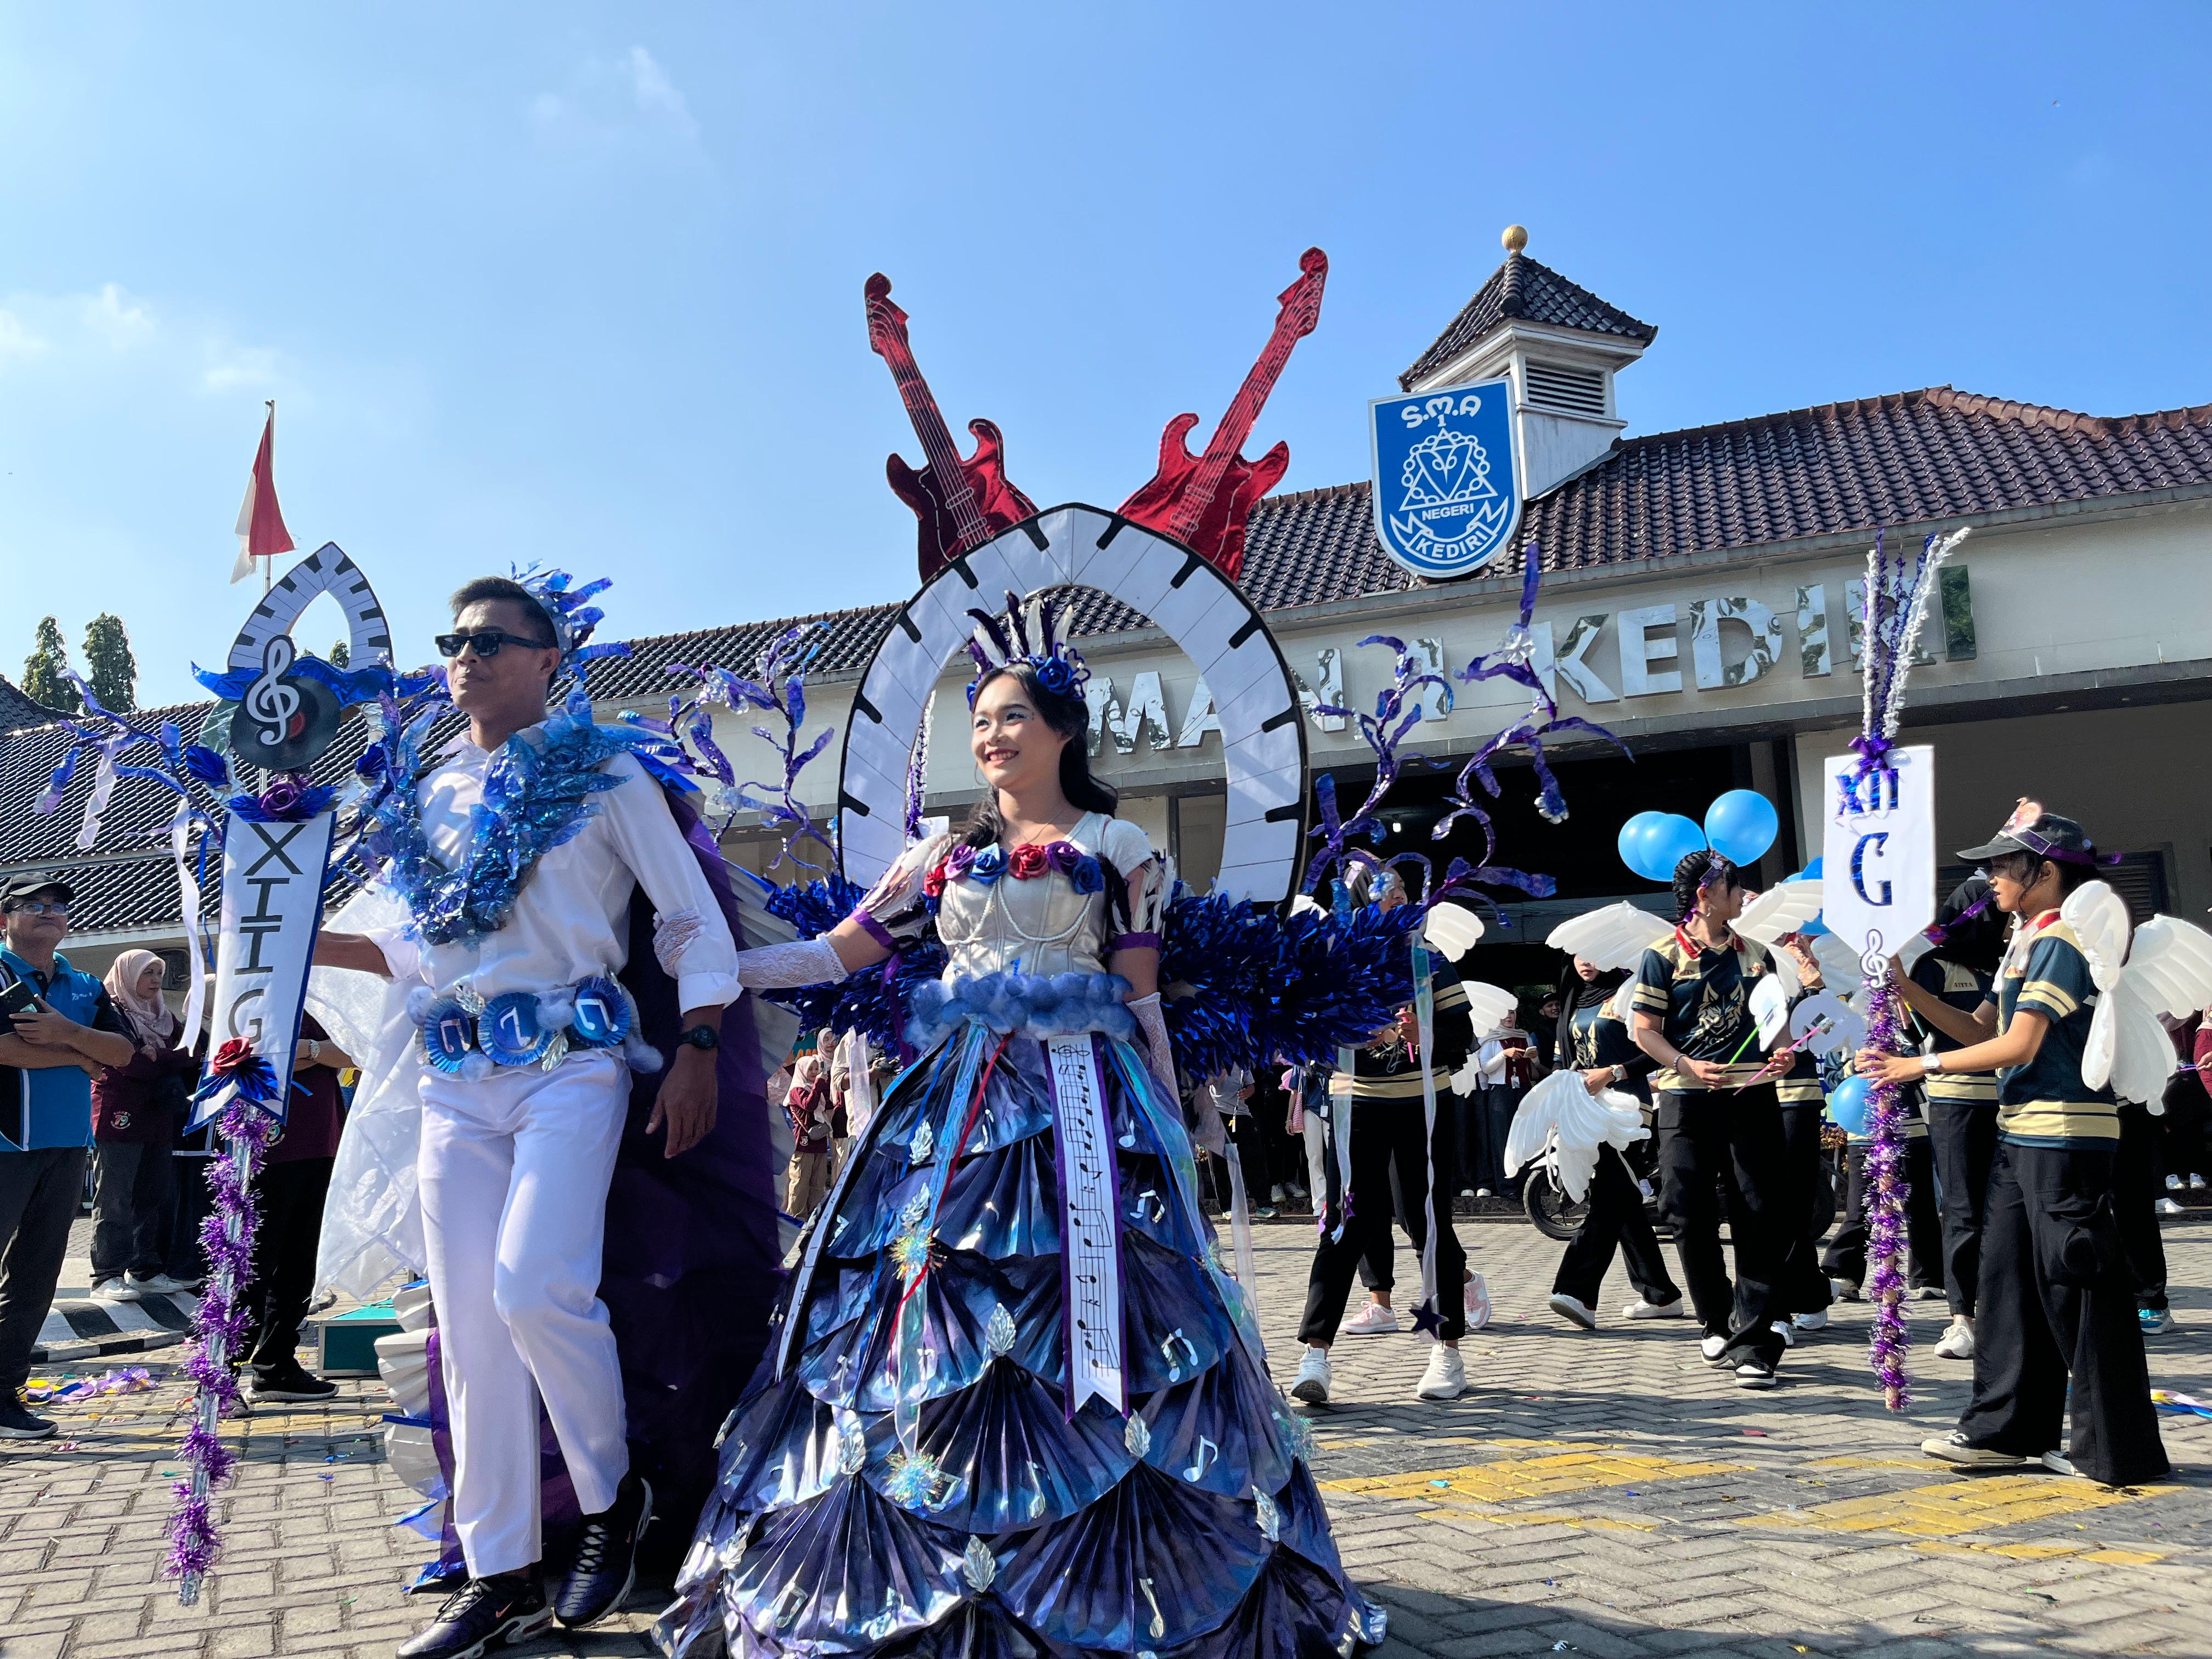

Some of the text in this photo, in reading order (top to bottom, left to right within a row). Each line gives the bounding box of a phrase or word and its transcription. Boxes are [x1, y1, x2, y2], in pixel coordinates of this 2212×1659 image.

[1401, 394, 1482, 429] S.M.A
[1437, 414, 1447, 427] 1
[1421, 503, 1475, 521] NEGERI
[1415, 532, 1489, 559] KEDIRI
[1531, 565, 1978, 711] KEDIRI
[1850, 832, 1893, 906] G
